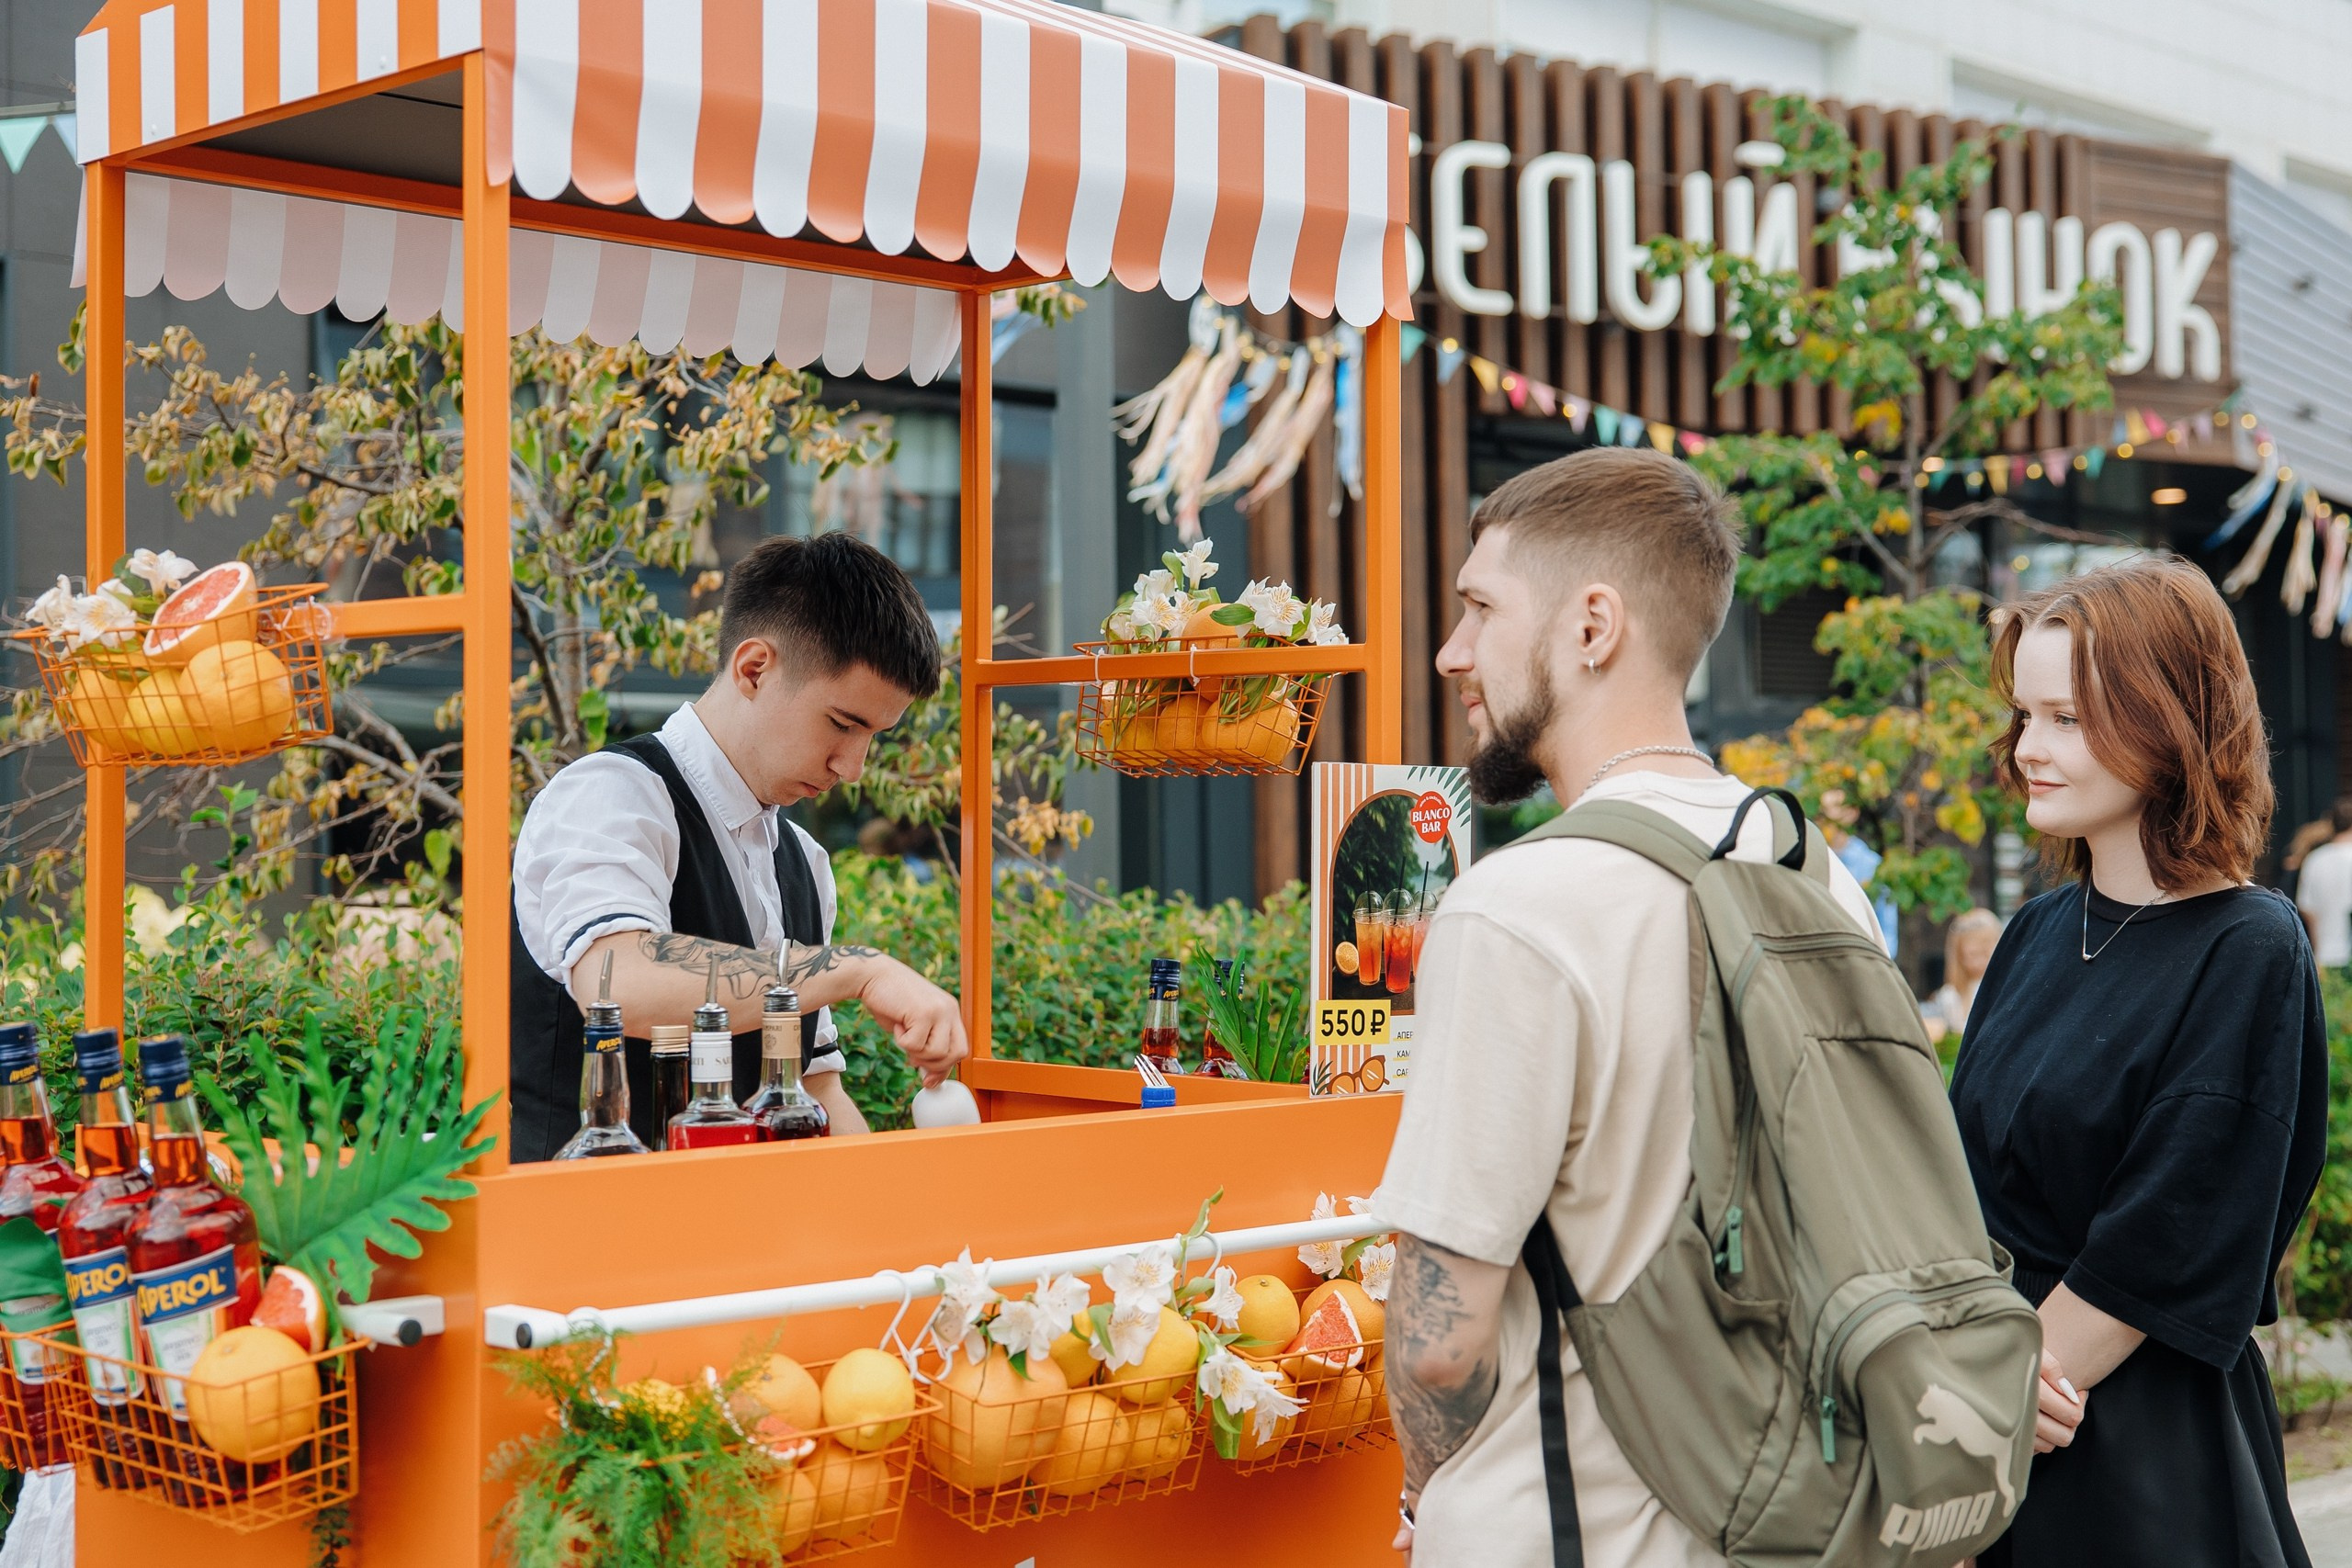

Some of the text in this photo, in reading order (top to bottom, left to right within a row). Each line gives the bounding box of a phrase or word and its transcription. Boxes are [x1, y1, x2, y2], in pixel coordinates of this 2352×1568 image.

[1407, 130, 1798, 346] ЕЛЫЙ
[1412, 807, 1450, 822] BLANCO
[1421, 821, 1441, 834] BAR
[136, 1268, 227, 1318] APEROL
[1879, 1490, 1996, 1554] PUMA
